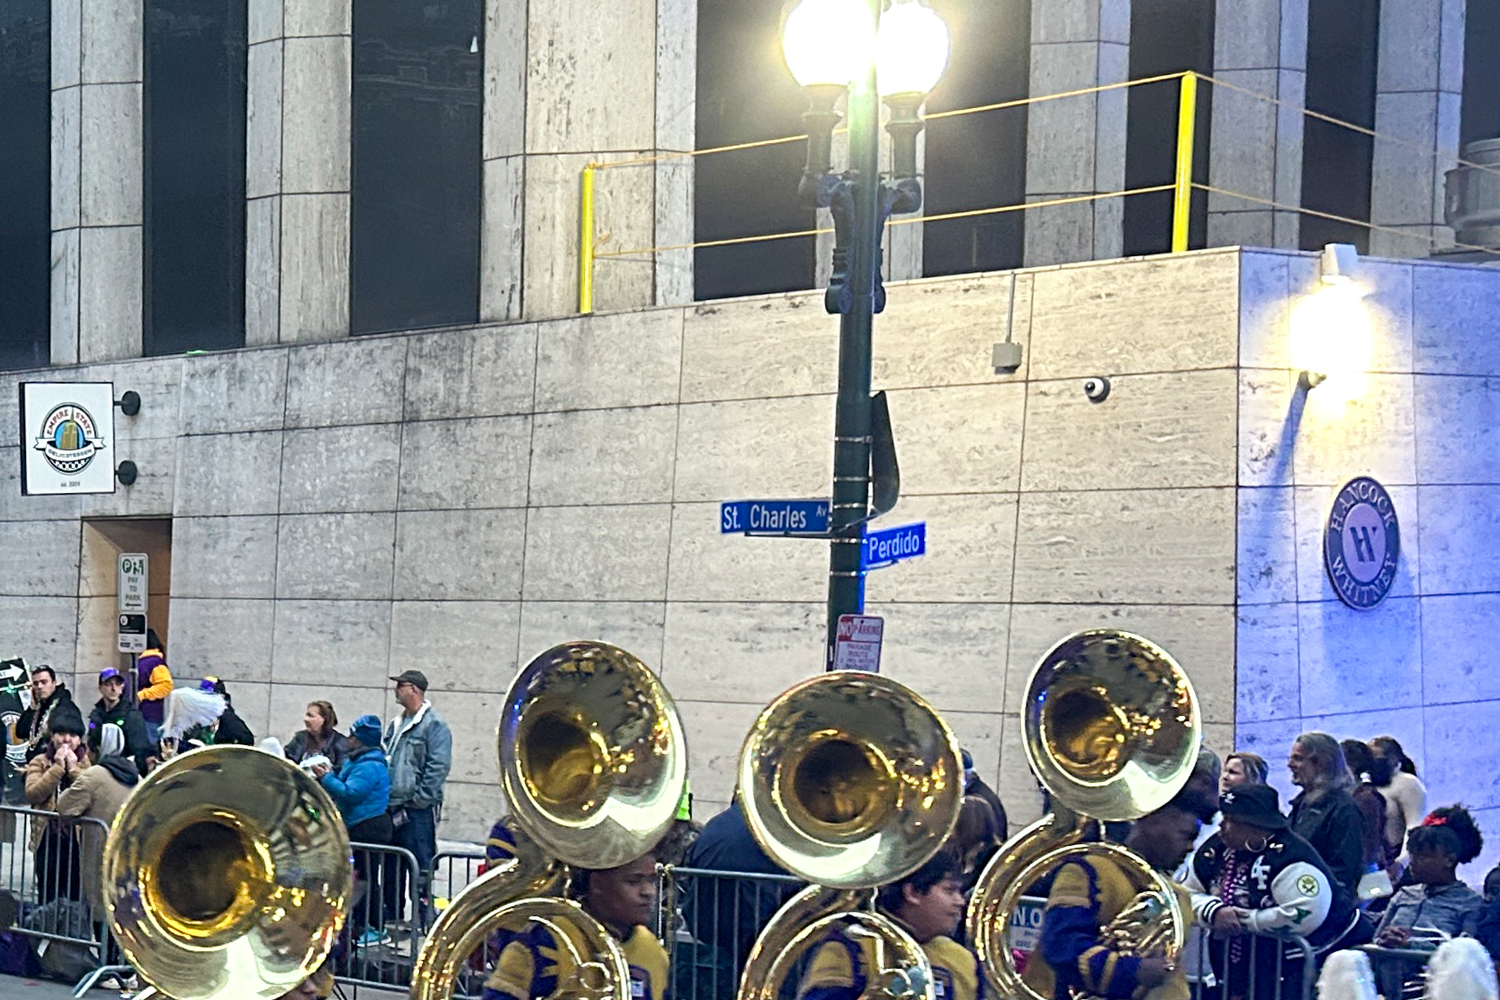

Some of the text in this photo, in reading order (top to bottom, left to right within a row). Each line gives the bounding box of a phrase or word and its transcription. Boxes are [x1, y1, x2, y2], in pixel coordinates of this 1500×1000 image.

[46, 409, 93, 436] EMPIRE STATE
[48, 448, 93, 459] DELICATESSEN
[723, 504, 828, 530] St. Charles Av
[1331, 481, 1395, 534] HANCOCK
[868, 533, 920, 561] Perdido
[127, 576, 139, 584] PAY
[1332, 553, 1396, 604] WHITNEY
[840, 621, 852, 637] NO
